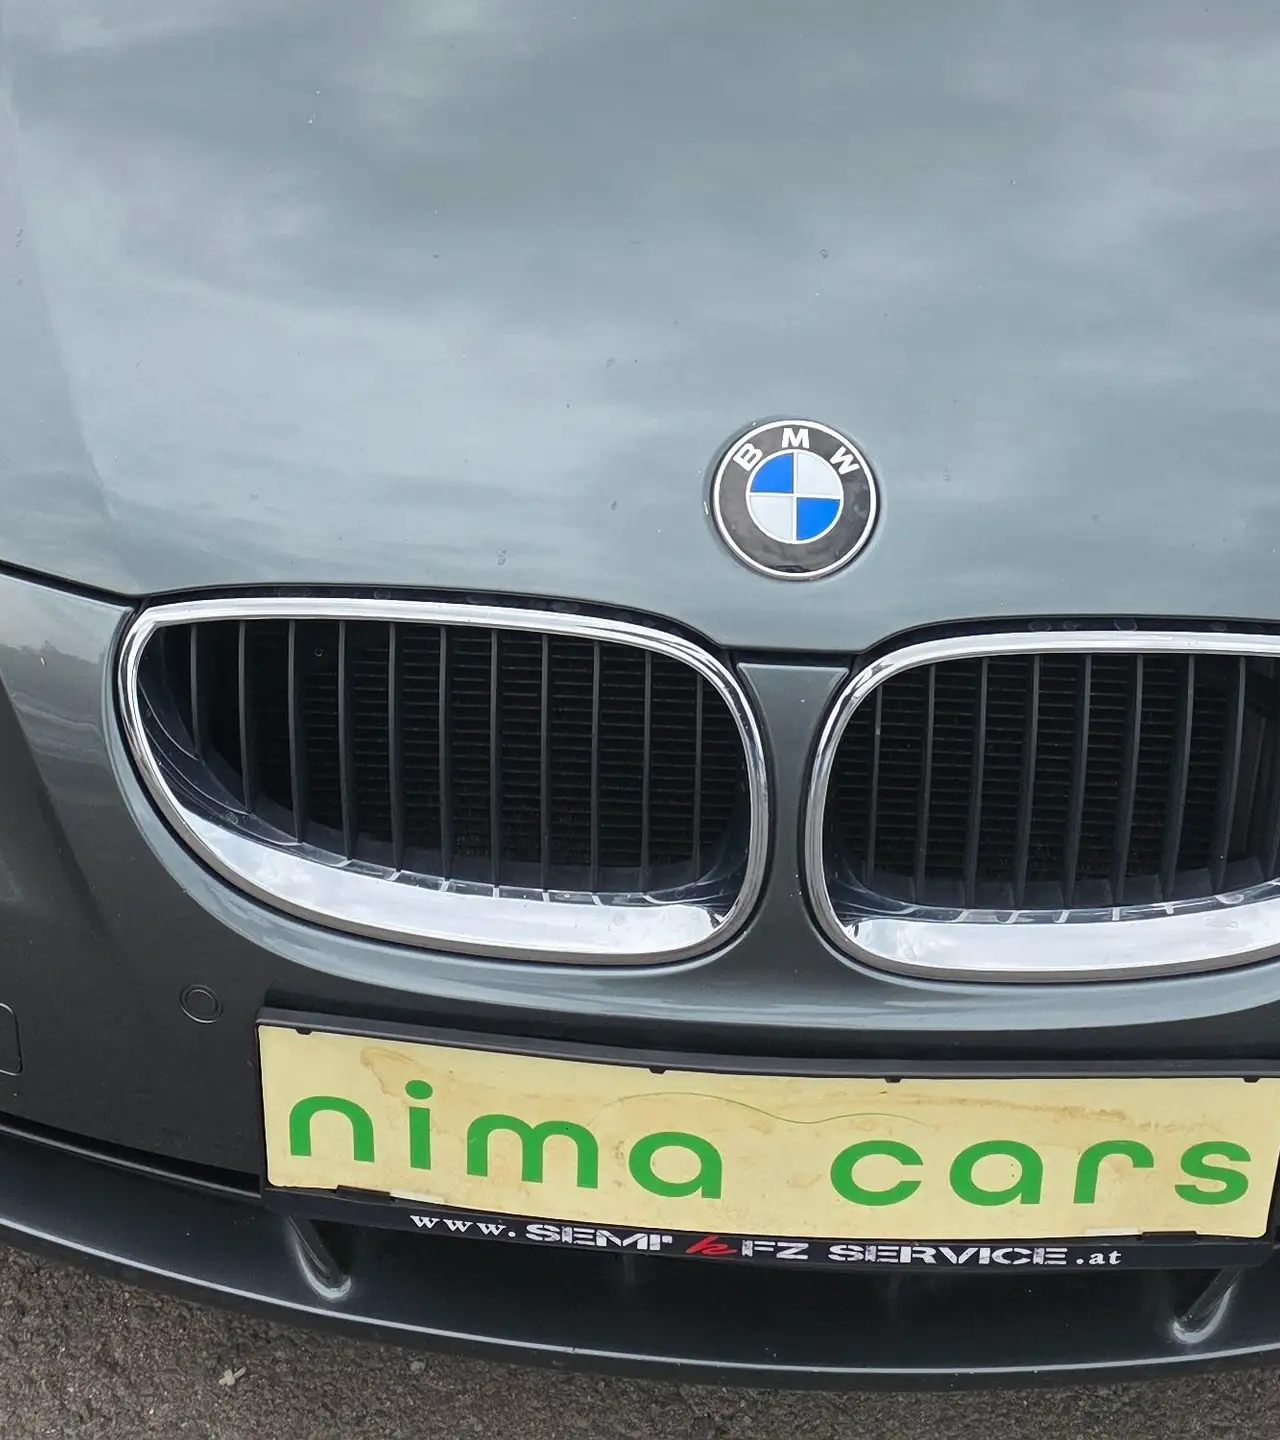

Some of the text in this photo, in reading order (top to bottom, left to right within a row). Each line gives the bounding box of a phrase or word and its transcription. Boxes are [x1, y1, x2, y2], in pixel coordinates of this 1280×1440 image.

[732, 427, 861, 476] BMW
[287, 1079, 1252, 1208] nima cars
